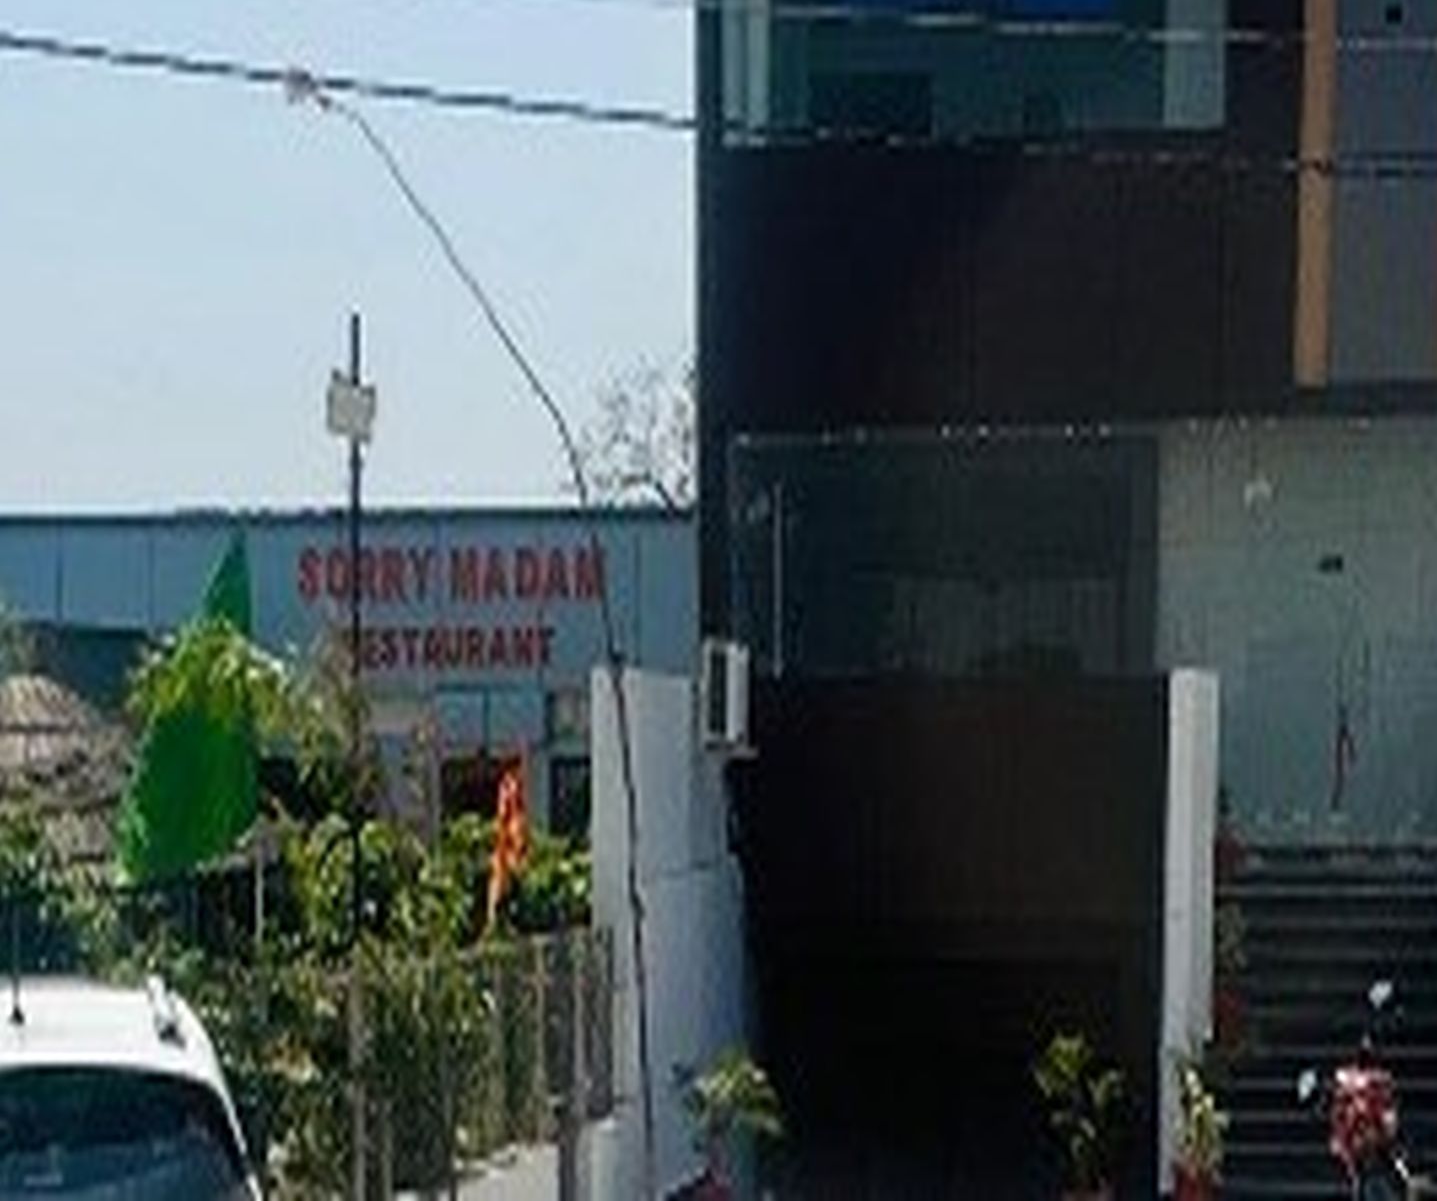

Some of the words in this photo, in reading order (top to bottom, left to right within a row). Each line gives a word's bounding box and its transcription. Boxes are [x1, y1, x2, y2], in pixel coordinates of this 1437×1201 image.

[298, 546, 432, 601] SORRY
[450, 546, 604, 599] MADAM
[342, 625, 554, 671] ESTAURANT
